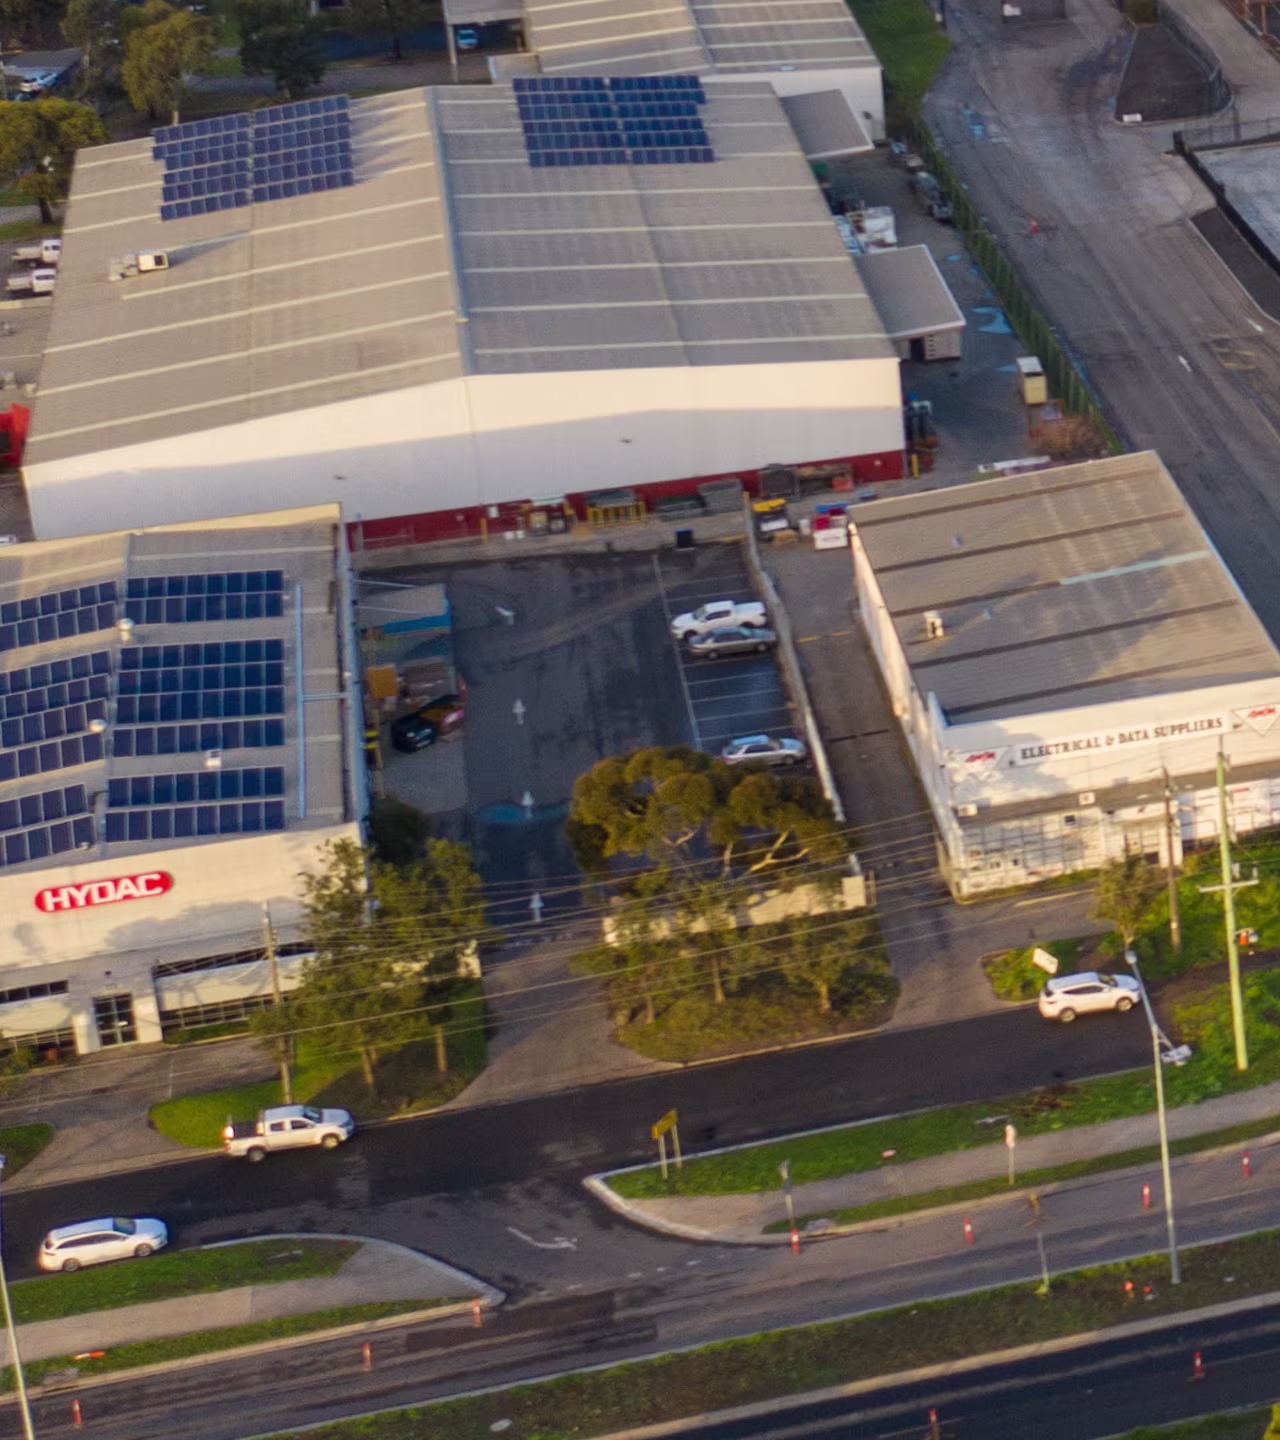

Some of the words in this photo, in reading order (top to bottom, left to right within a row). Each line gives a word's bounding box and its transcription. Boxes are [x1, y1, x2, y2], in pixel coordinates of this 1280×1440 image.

[1021, 737, 1101, 760] ELECTRICAL
[1105, 735, 1115, 746] &
[1118, 729, 1150, 744] DATA
[1153, 717, 1223, 738] SUPPLIERS
[44, 873, 164, 911] HYDAC
